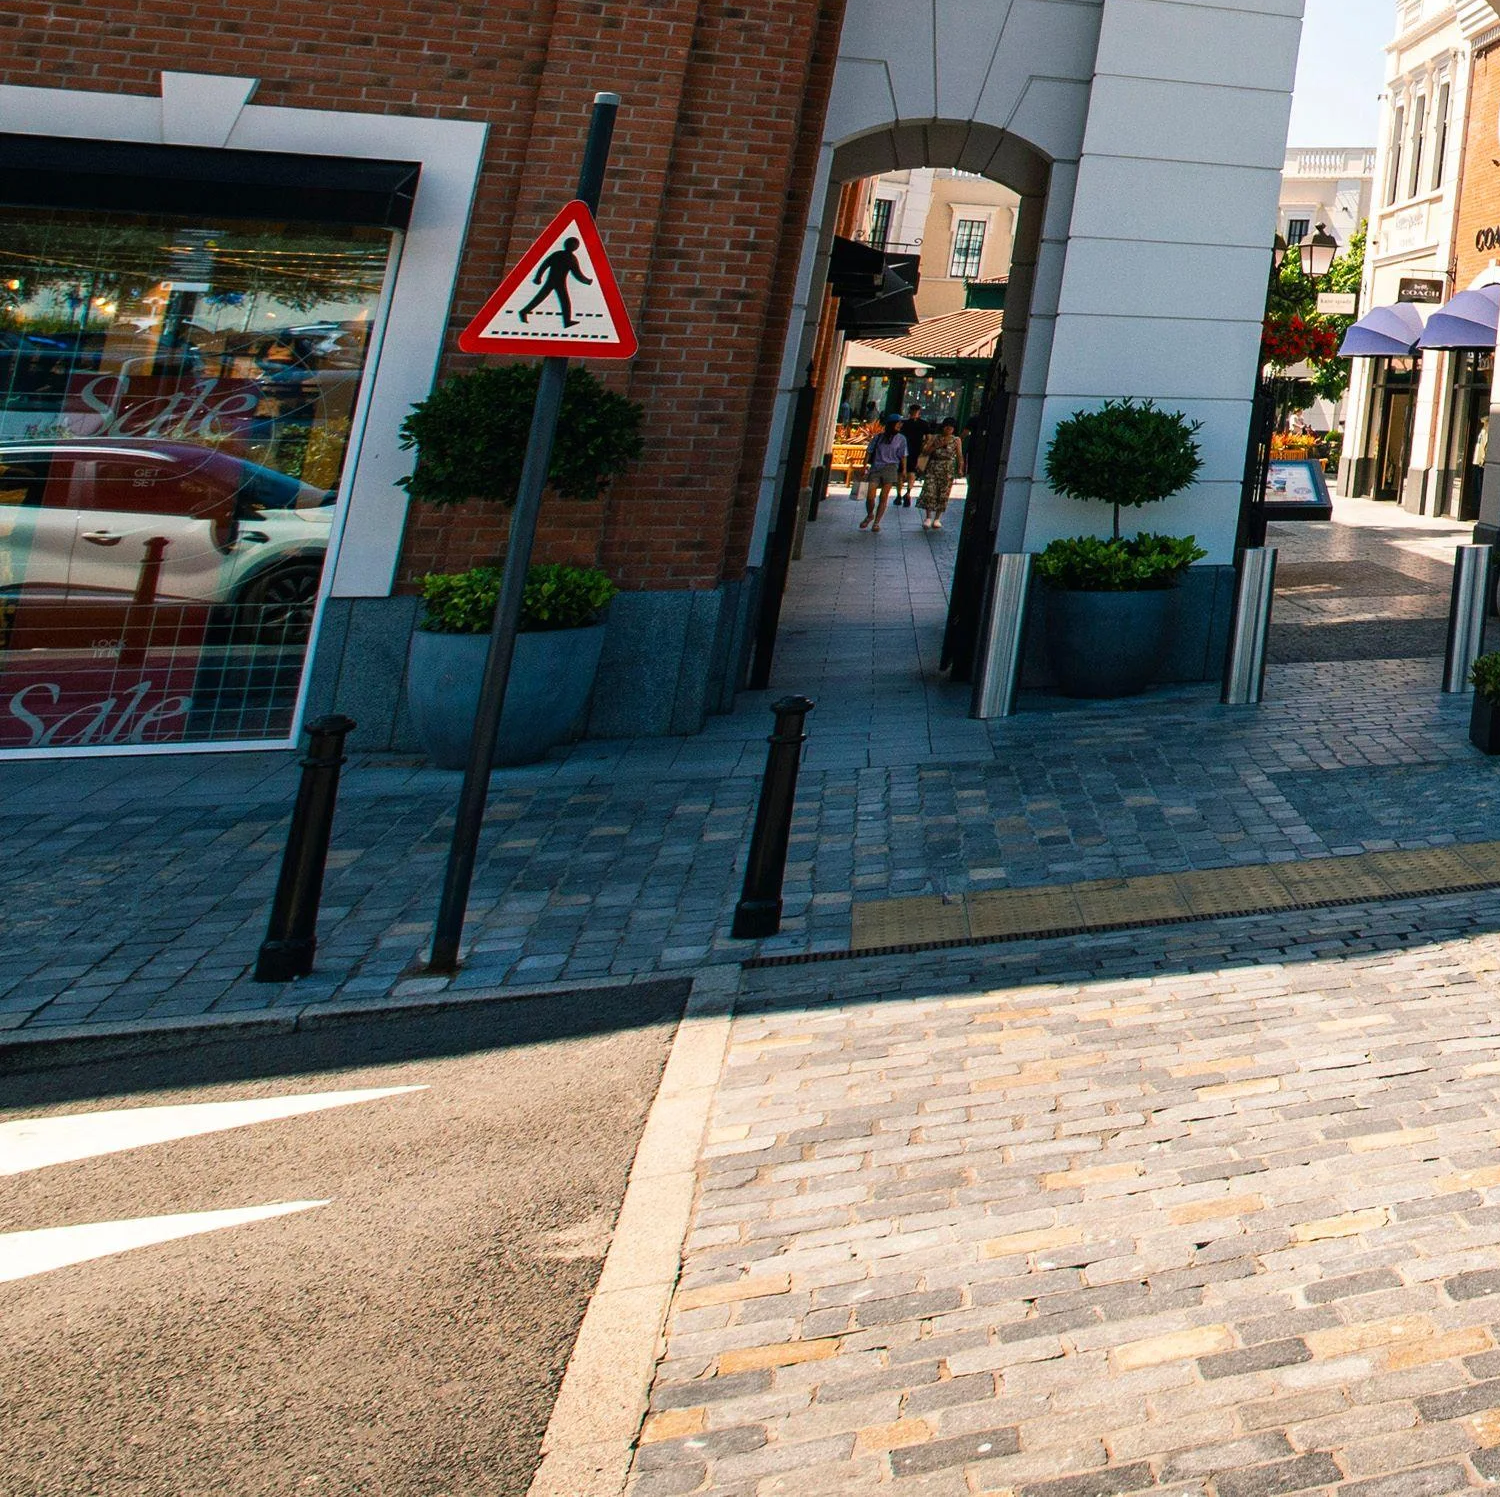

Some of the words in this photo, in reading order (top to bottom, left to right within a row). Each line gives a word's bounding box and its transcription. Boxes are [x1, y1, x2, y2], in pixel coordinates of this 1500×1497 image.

[1401, 289, 1440, 297] COACH
[80, 375, 259, 440] Sale
[9, 680, 194, 745] Sale
